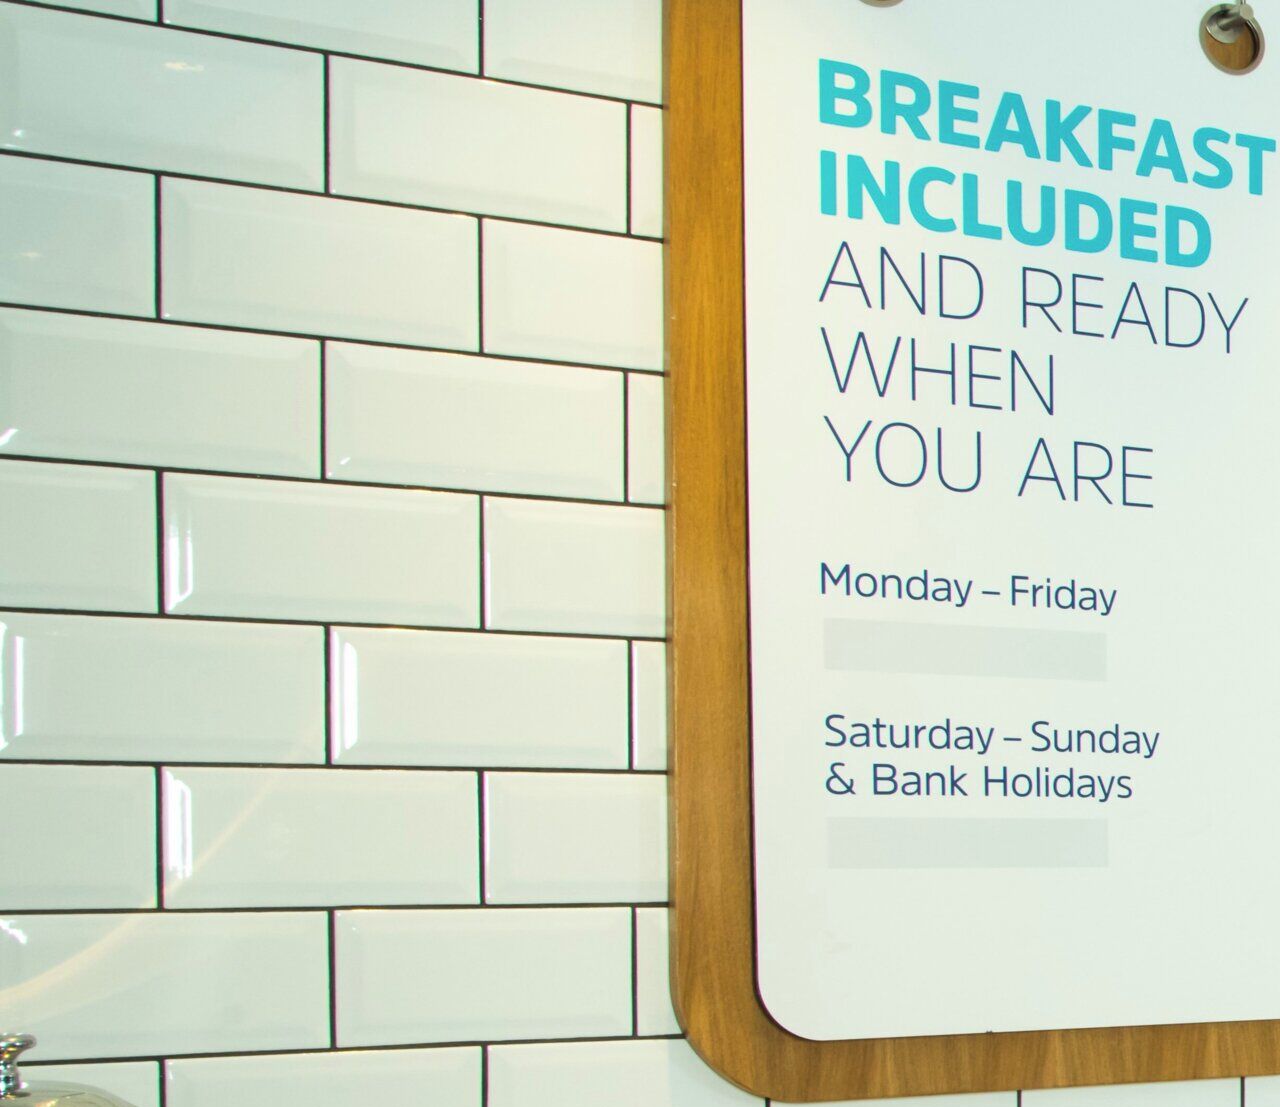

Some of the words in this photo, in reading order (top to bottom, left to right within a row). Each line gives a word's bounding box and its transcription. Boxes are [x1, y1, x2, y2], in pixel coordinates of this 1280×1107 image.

[817, 58, 1276, 195] BREAKFAST
[819, 150, 1212, 268] INCLUDED
[818, 240, 984, 321] AND
[1020, 267, 1249, 354] READY
[820, 327, 1055, 416] WHEN
[823, 415, 982, 493] YOU
[1017, 437, 1155, 509] ARE
[820, 562, 973, 608] Monday
[1010, 575, 1117, 616] Friday
[824, 714, 995, 755] Saturday
[1031, 721, 1160, 759] Sunday
[825, 762, 856, 796] &
[872, 763, 968, 797] Bank
[984, 766, 1133, 803] Holidays
